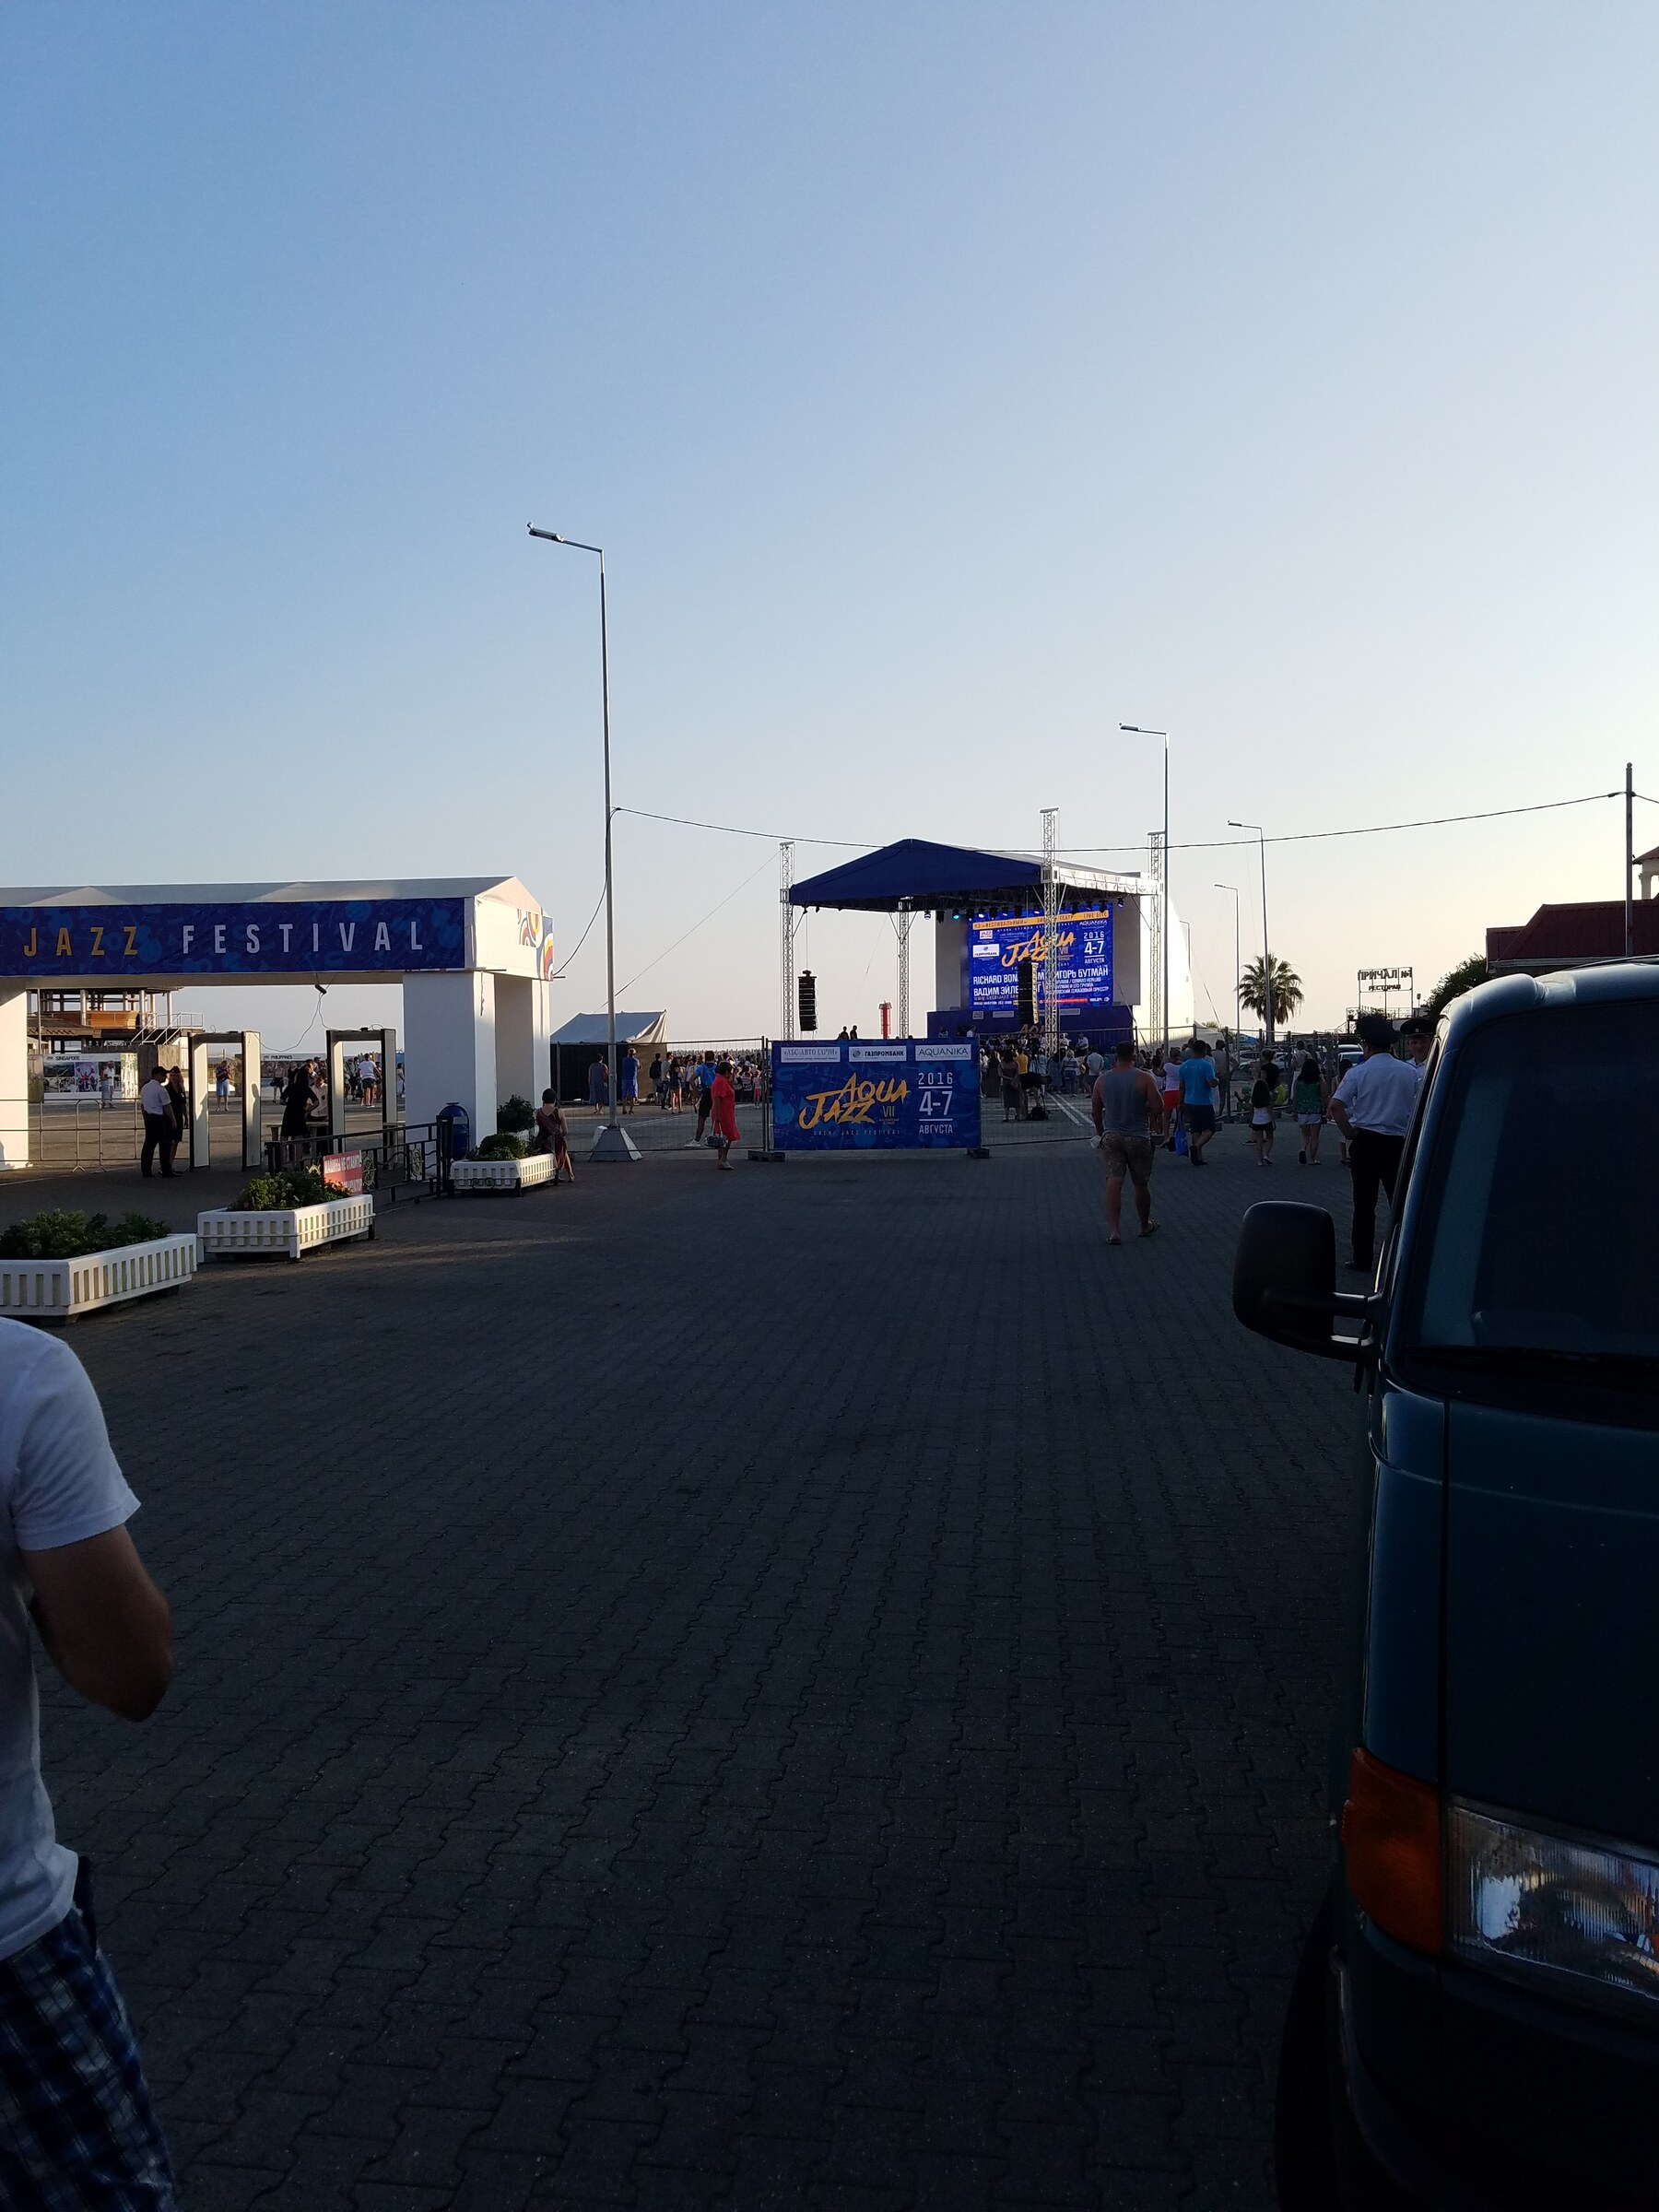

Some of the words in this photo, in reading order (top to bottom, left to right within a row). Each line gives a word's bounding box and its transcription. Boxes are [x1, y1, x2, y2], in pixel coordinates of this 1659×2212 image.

[24, 926, 138, 957] JAZZ
[182, 921, 423, 954] FESTIVAL
[1084, 931, 1105, 939] 2016
[1084, 940, 1105, 955] 4-7
[1078, 967, 1109, 978] БУТМАН
[1358, 969, 1398, 981] ПРИЧАЛ
[973, 975, 1003, 985] RICHARD
[1003, 973, 1018, 983] BON
[973, 987, 1000, 996] ВАДИМ
[918, 1047, 969, 1056] AQUANIKA
[918, 1072, 953, 1086] 2016
[833, 1072, 912, 1105] AQUA
[919, 1090, 953, 1116] 4-7
[798, 1093, 876, 1130] JAZZ
[882, 1105, 895, 1118] VII
[919, 1124, 954, 1135] АВГУСТА
